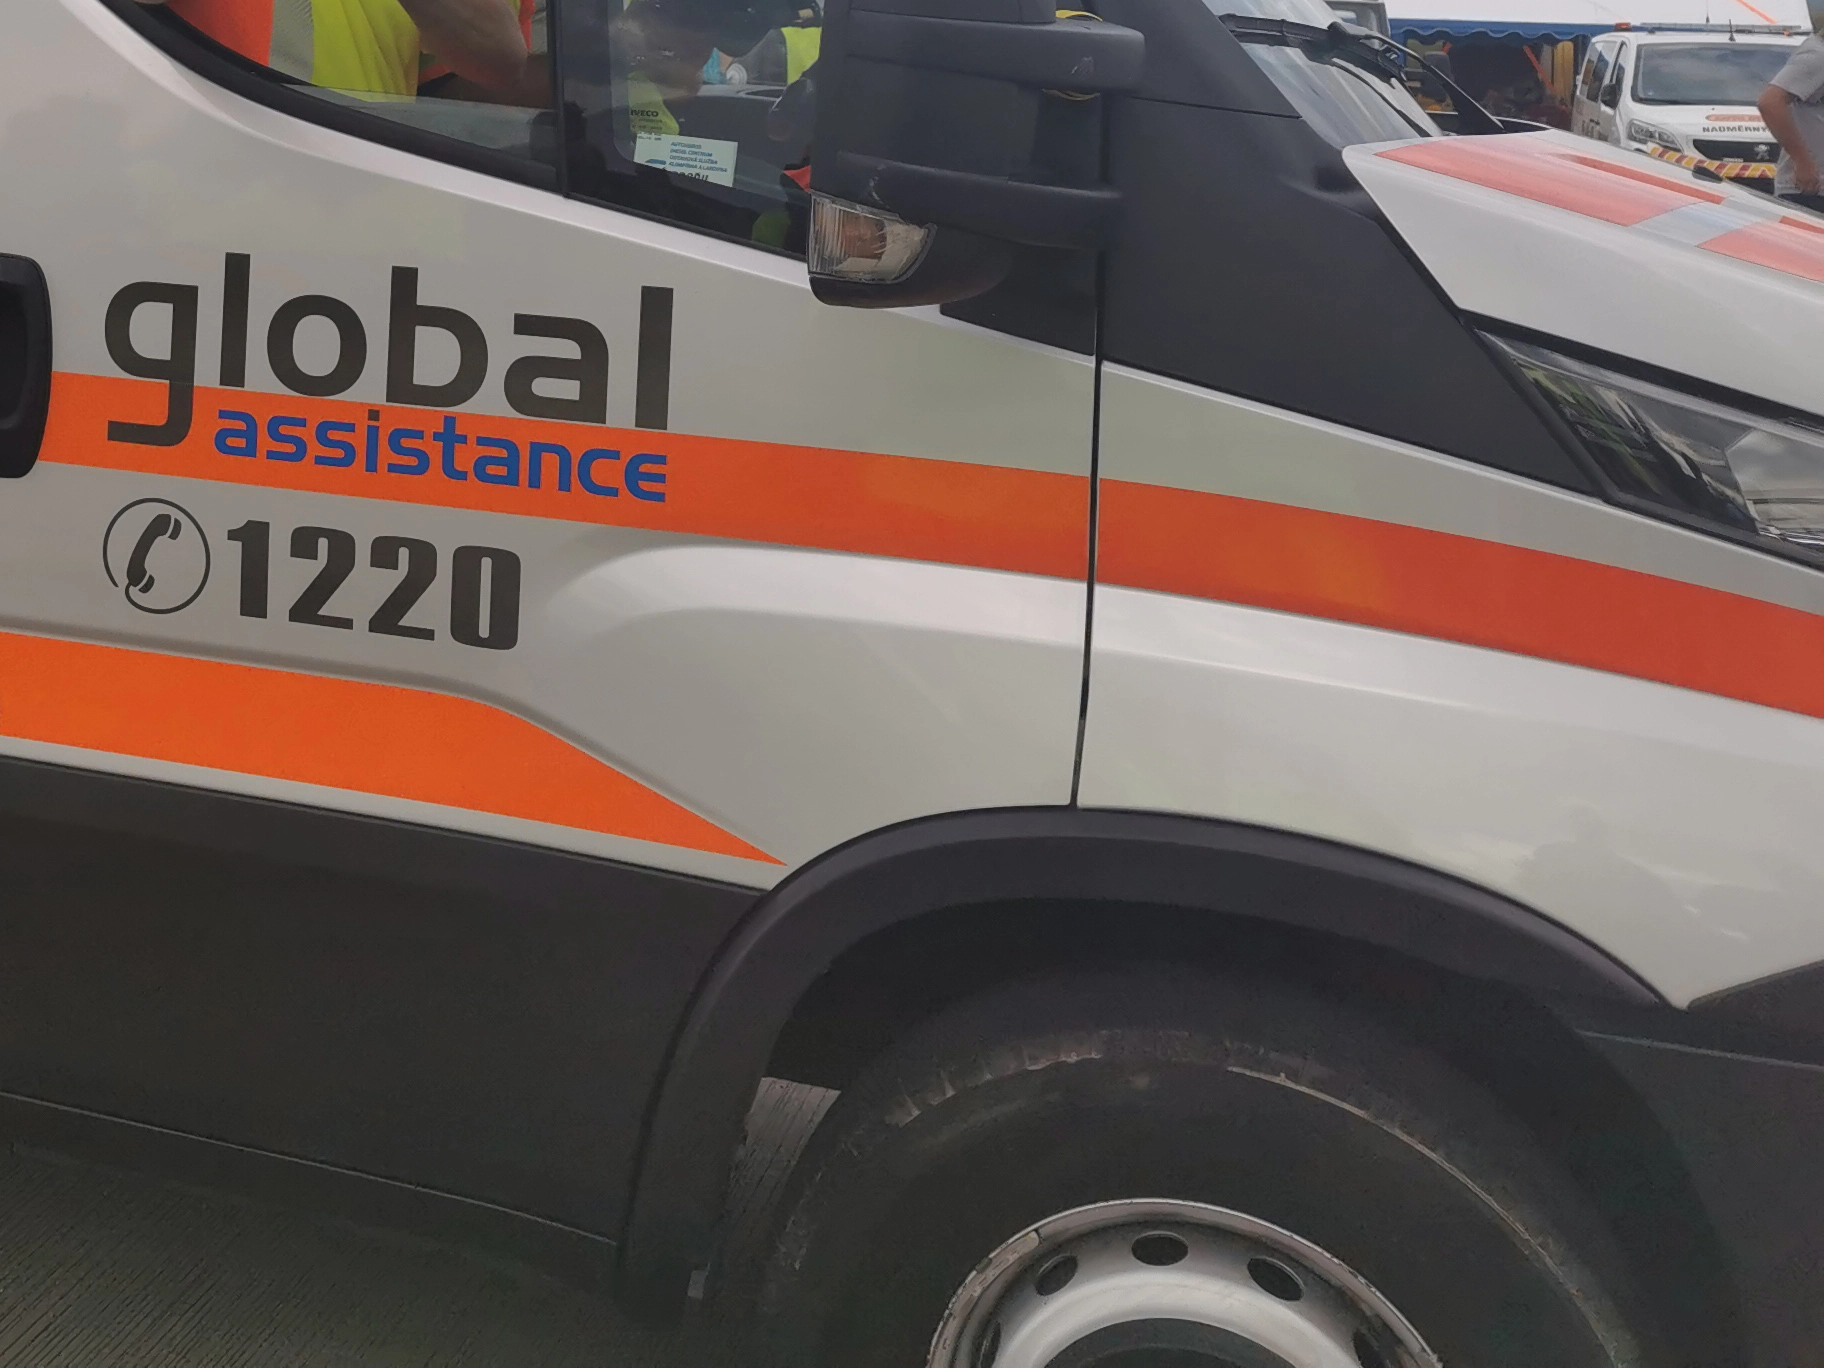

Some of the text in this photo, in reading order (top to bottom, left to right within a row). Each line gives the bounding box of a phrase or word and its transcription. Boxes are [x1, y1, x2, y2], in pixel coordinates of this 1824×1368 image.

[630, 109, 659, 118] IVECO
[104, 252, 674, 447] global
[214, 408, 667, 502] assistance
[227, 519, 522, 651] 1220
